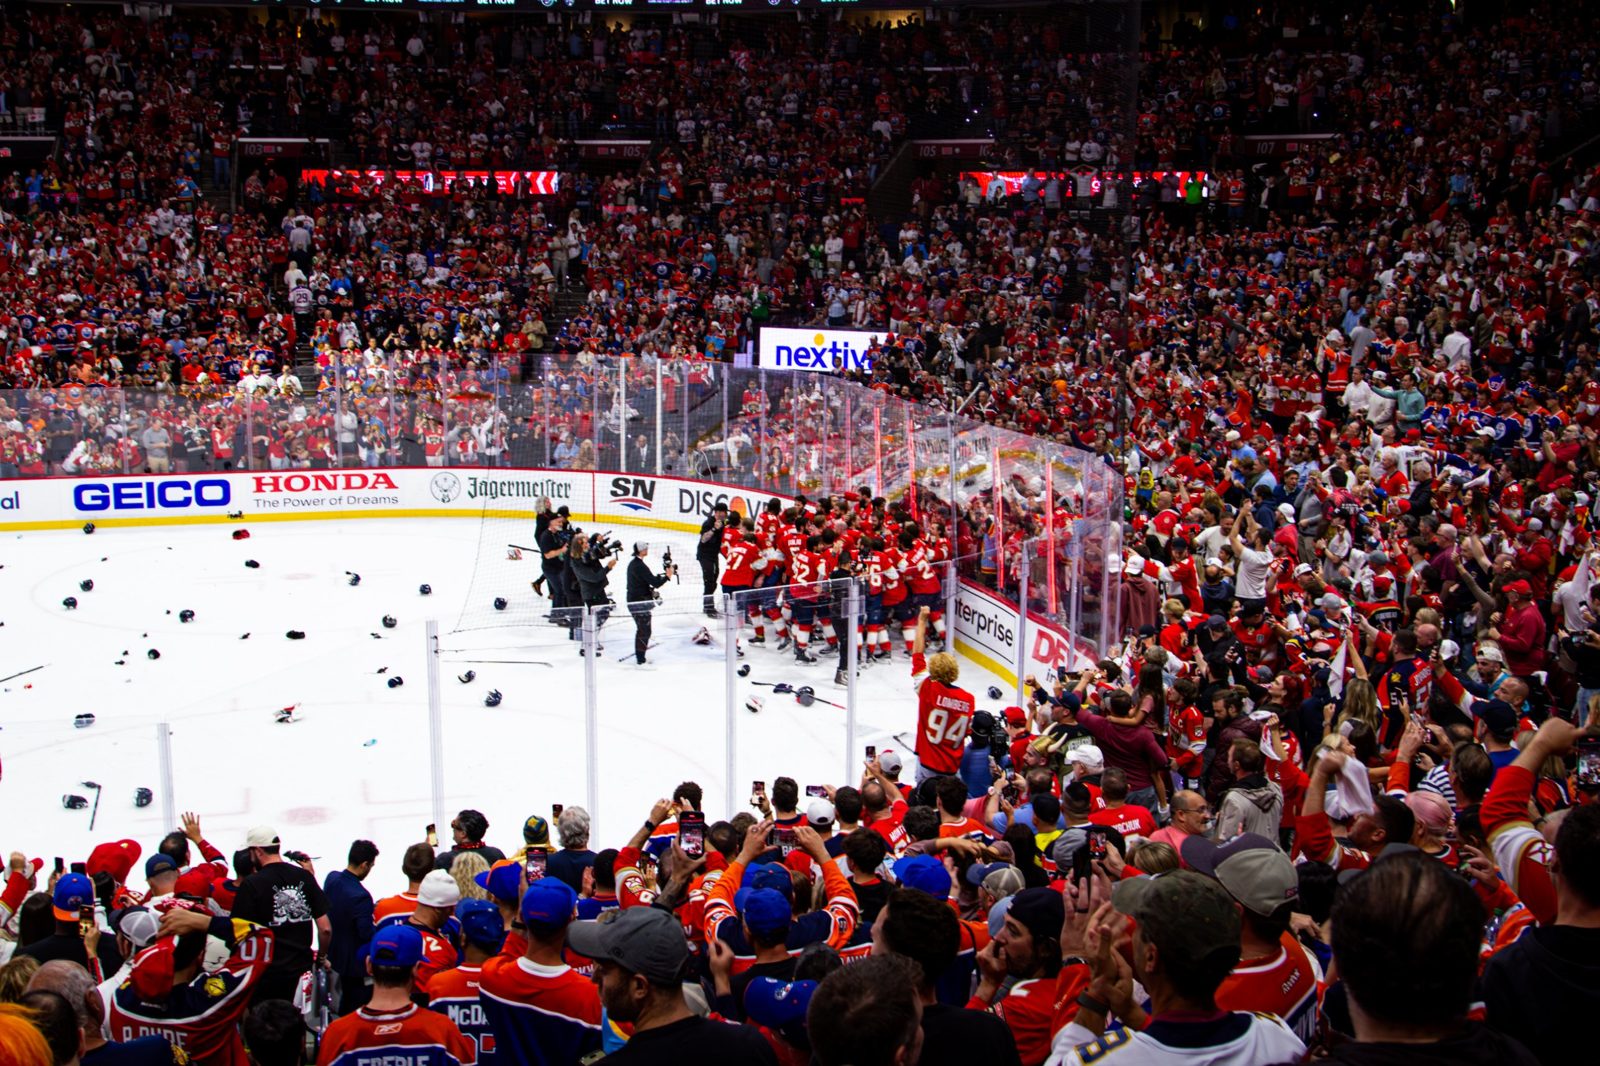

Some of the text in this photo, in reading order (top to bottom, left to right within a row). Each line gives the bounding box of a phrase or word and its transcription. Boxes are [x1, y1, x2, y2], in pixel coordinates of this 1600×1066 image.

[623, 146, 641, 157] 105
[919, 146, 937, 157] 105
[1256, 142, 1276, 155] 107
[776, 341, 871, 371] nextiv
[252, 473, 399, 493] HONDA
[610, 477, 656, 502] SN
[73, 479, 231, 511] GEICO
[253, 495, 399, 508] The Power of Dreams
[926, 709, 969, 749] 94
